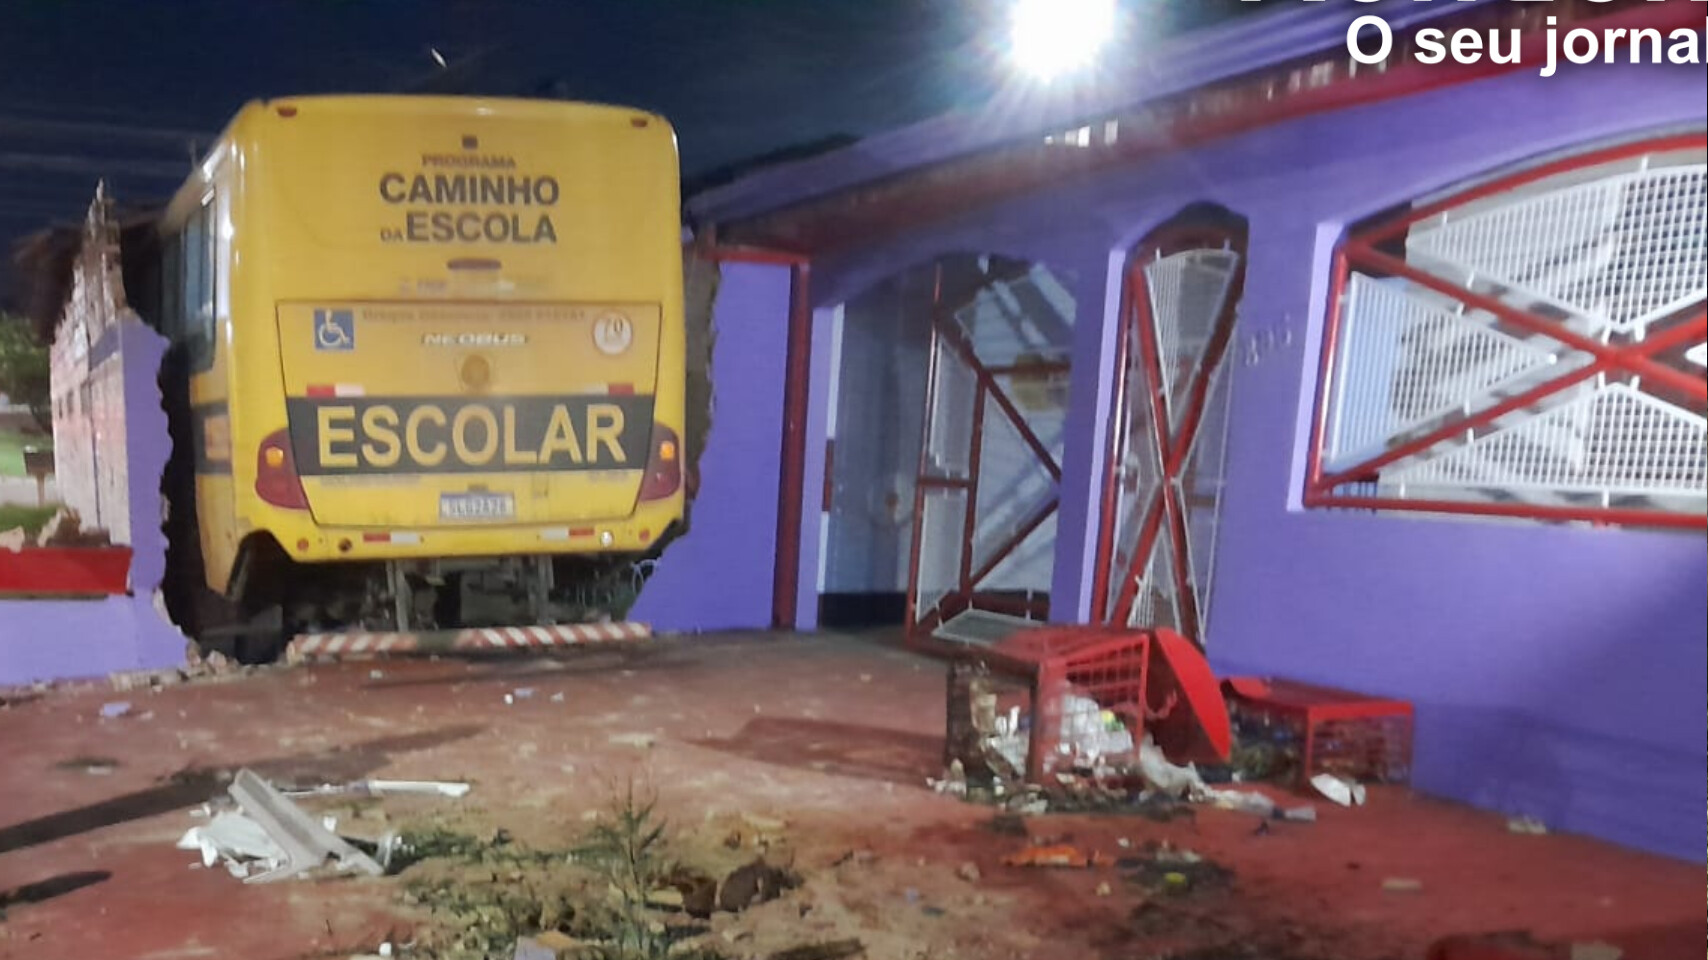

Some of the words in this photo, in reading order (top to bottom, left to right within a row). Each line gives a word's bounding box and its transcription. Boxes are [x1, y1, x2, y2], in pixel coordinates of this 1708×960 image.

[421, 154, 516, 170] PROGRAMA
[379, 172, 560, 206] CAMINHO
[406, 211, 557, 244] ESCOLA
[317, 403, 627, 468] ESCOLAR
